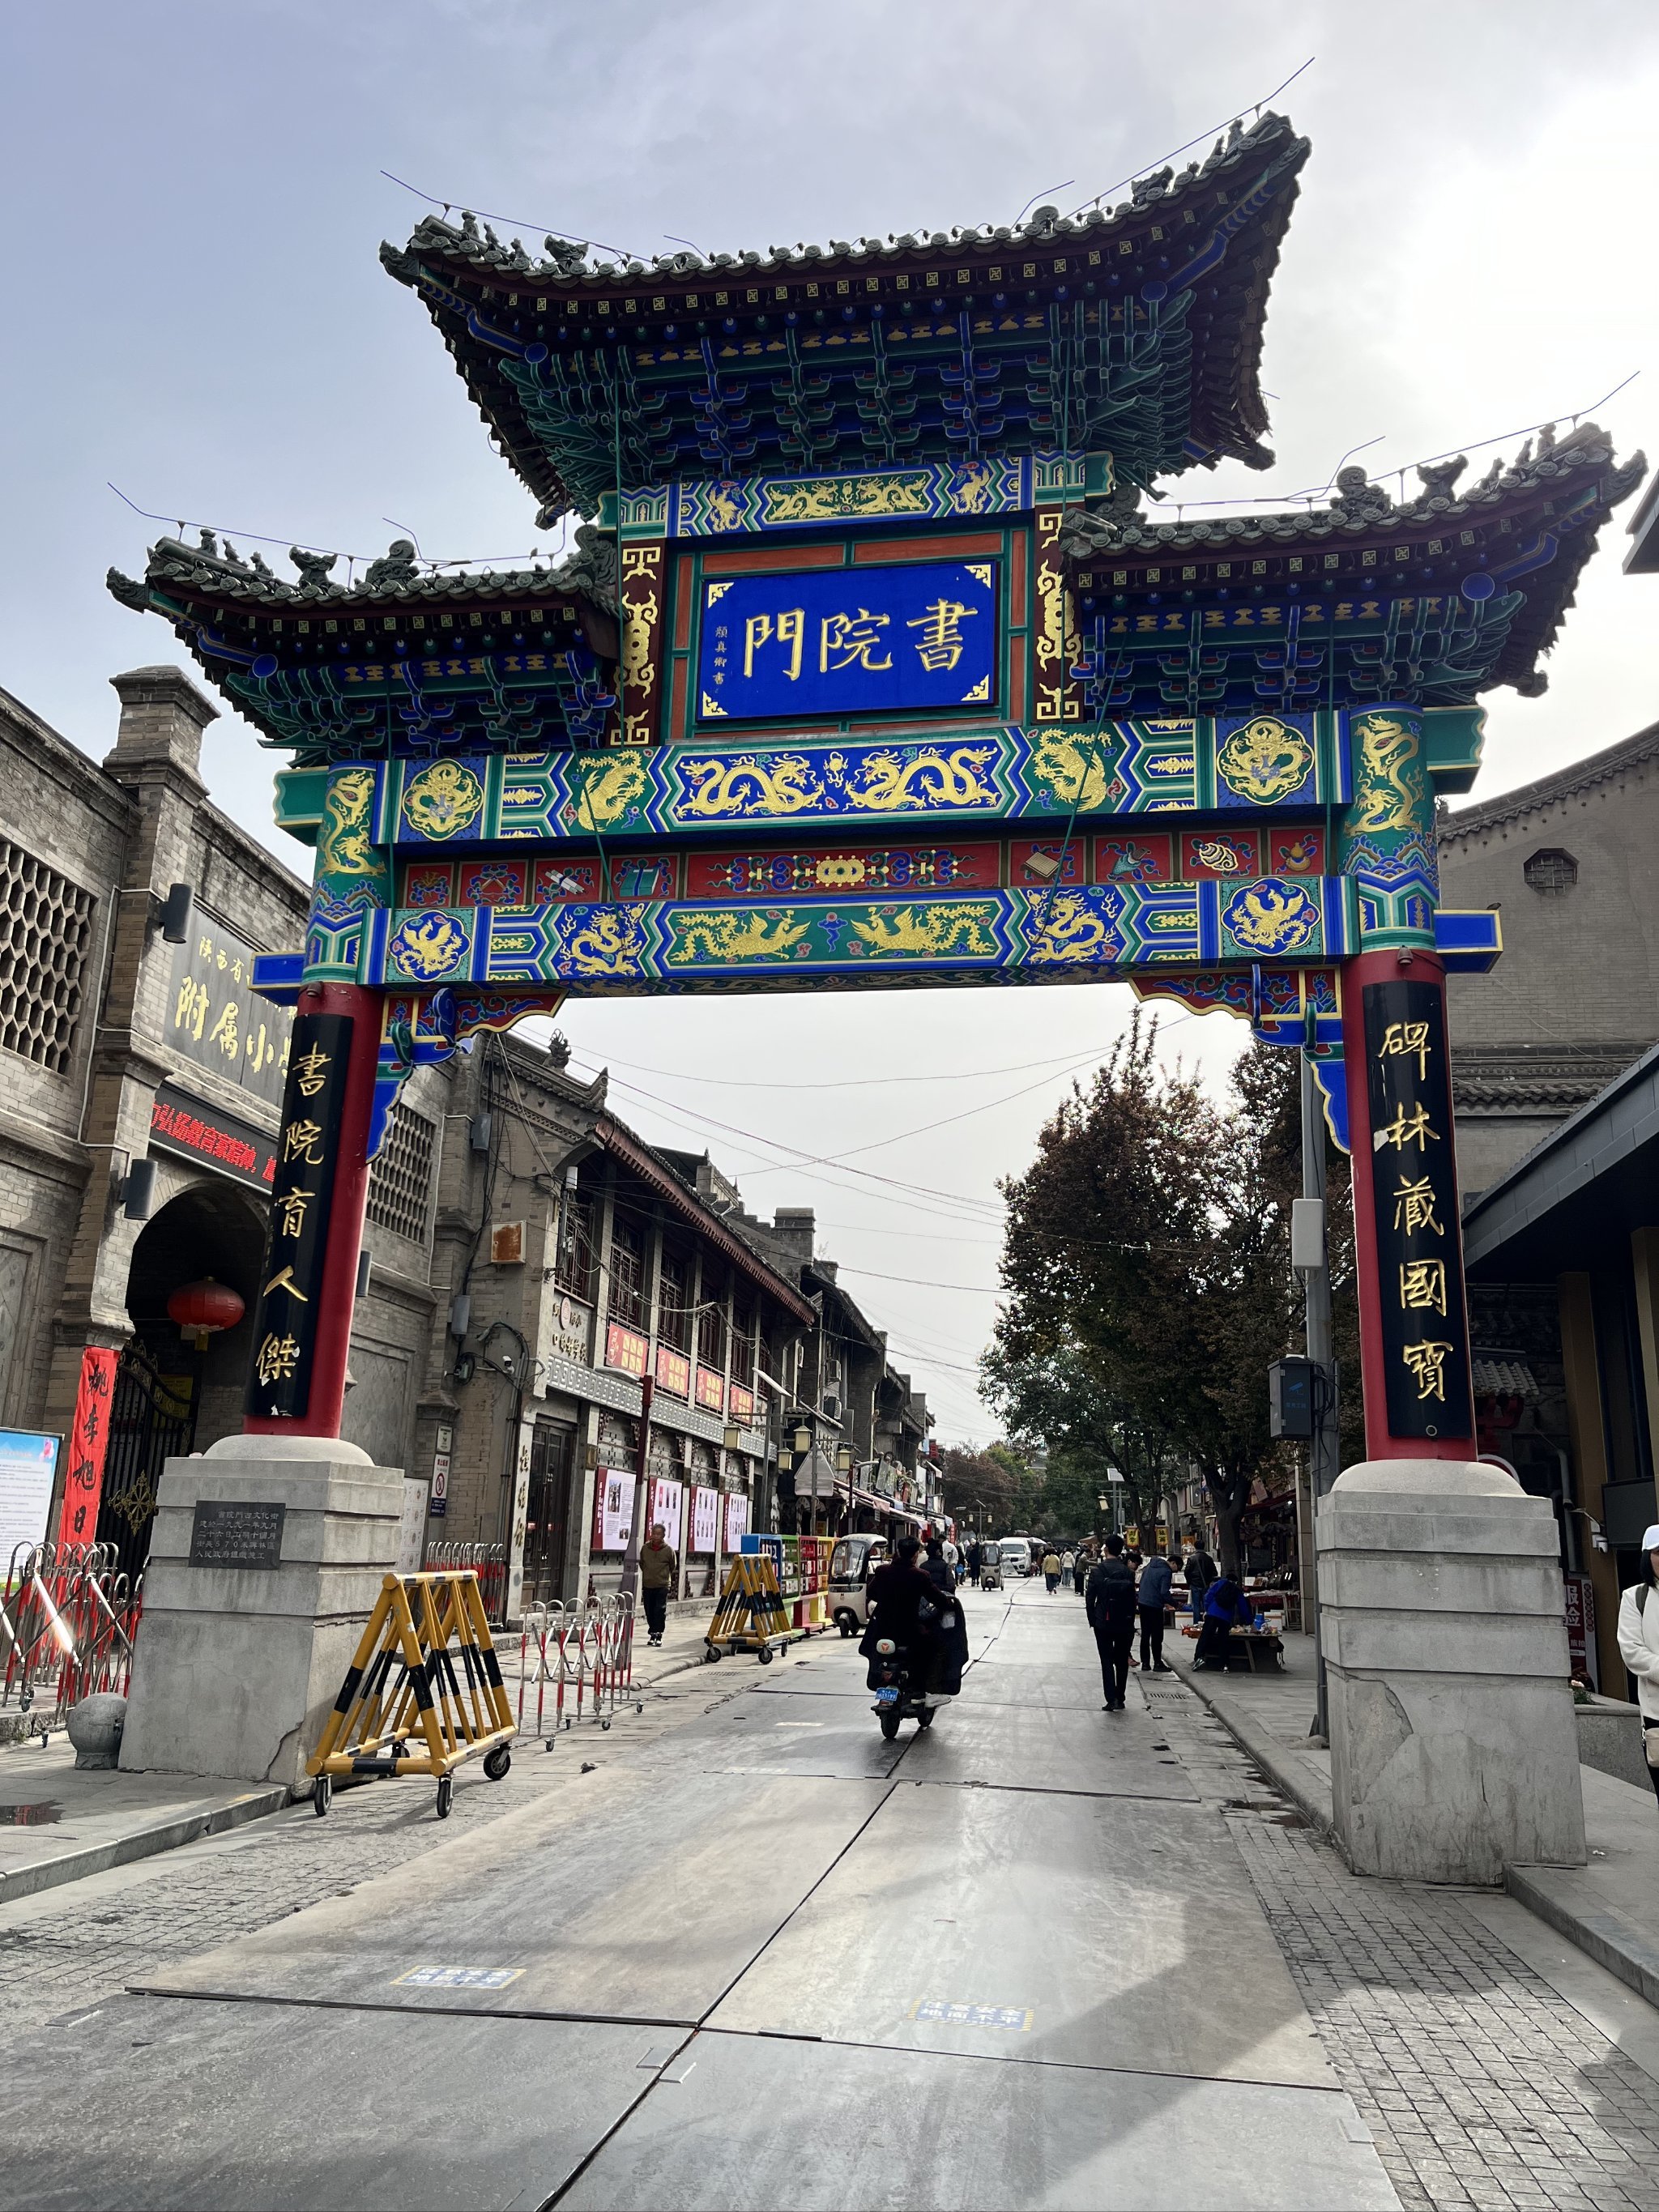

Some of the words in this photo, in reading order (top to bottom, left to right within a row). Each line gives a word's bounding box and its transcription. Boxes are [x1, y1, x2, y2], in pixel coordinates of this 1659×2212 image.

[743, 598, 979, 681] 書院門
[256, 1040, 332, 1379] 書院育人傑
[920, 2009, 1021, 2023] 地面不平
[925, 2001, 1022, 2017] 注意安全
